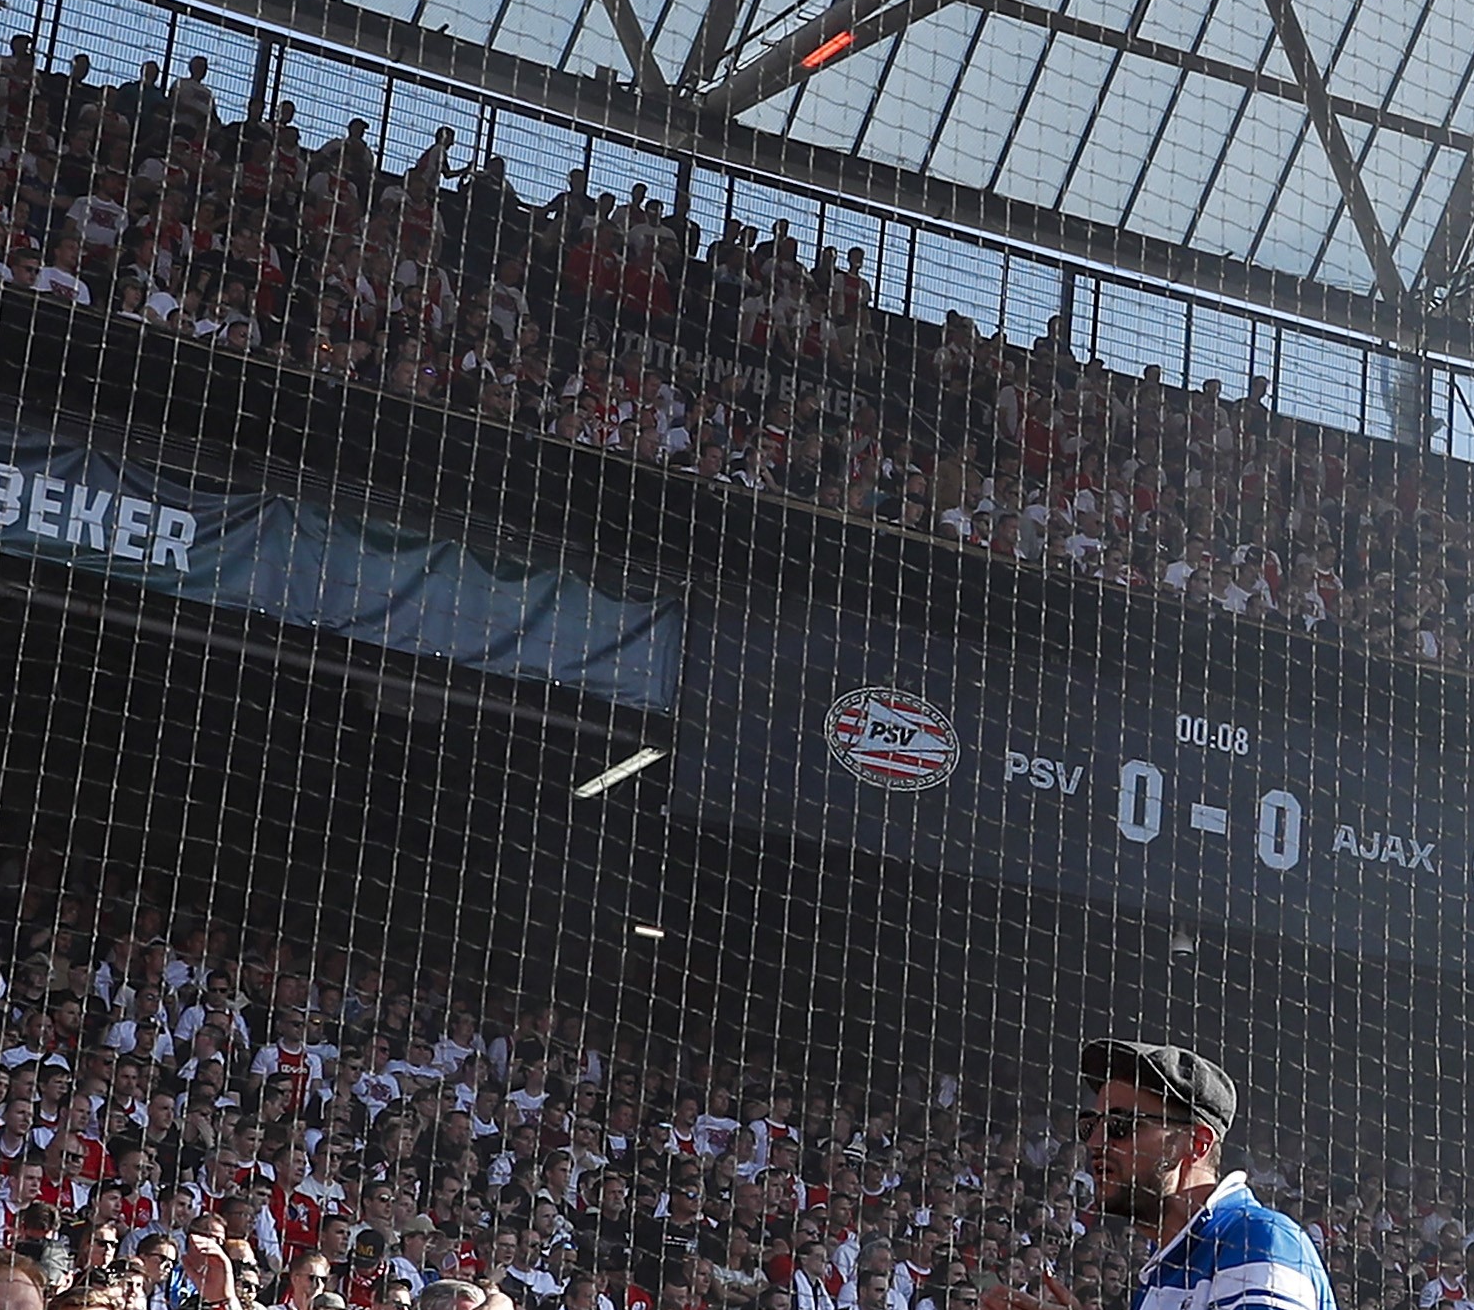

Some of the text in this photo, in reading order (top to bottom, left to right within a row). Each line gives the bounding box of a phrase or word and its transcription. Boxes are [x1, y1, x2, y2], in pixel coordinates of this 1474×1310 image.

[869, 721, 918, 747] PSV
[1176, 713, 1249, 756] 00:08
[1004, 750, 1085, 795] PSV
[1118, 758, 1162, 844] 0
[1258, 789, 1302, 871] 0
[1332, 825, 1436, 873] AJAX
